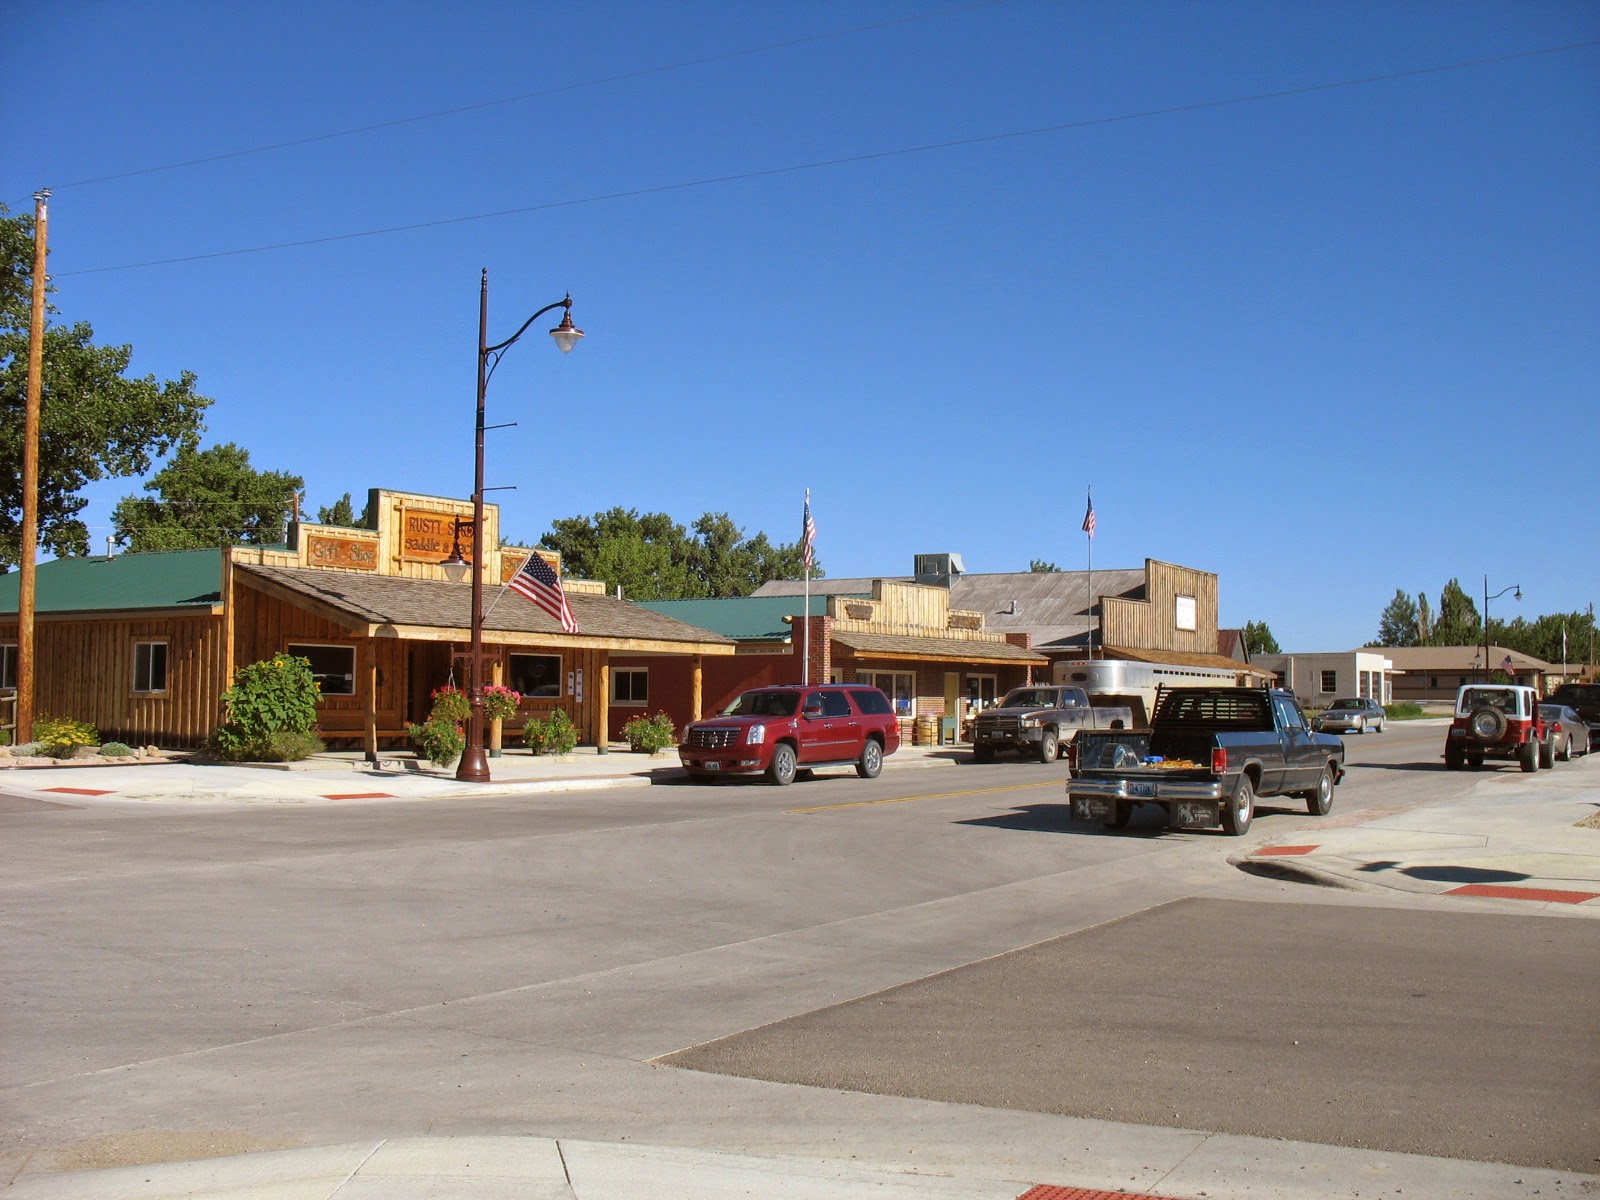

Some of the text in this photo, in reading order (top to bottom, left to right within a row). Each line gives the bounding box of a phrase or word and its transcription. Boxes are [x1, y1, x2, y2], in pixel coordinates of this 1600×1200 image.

[409, 516, 442, 534] RUSTY
[314, 541, 374, 564] Gift Shop
